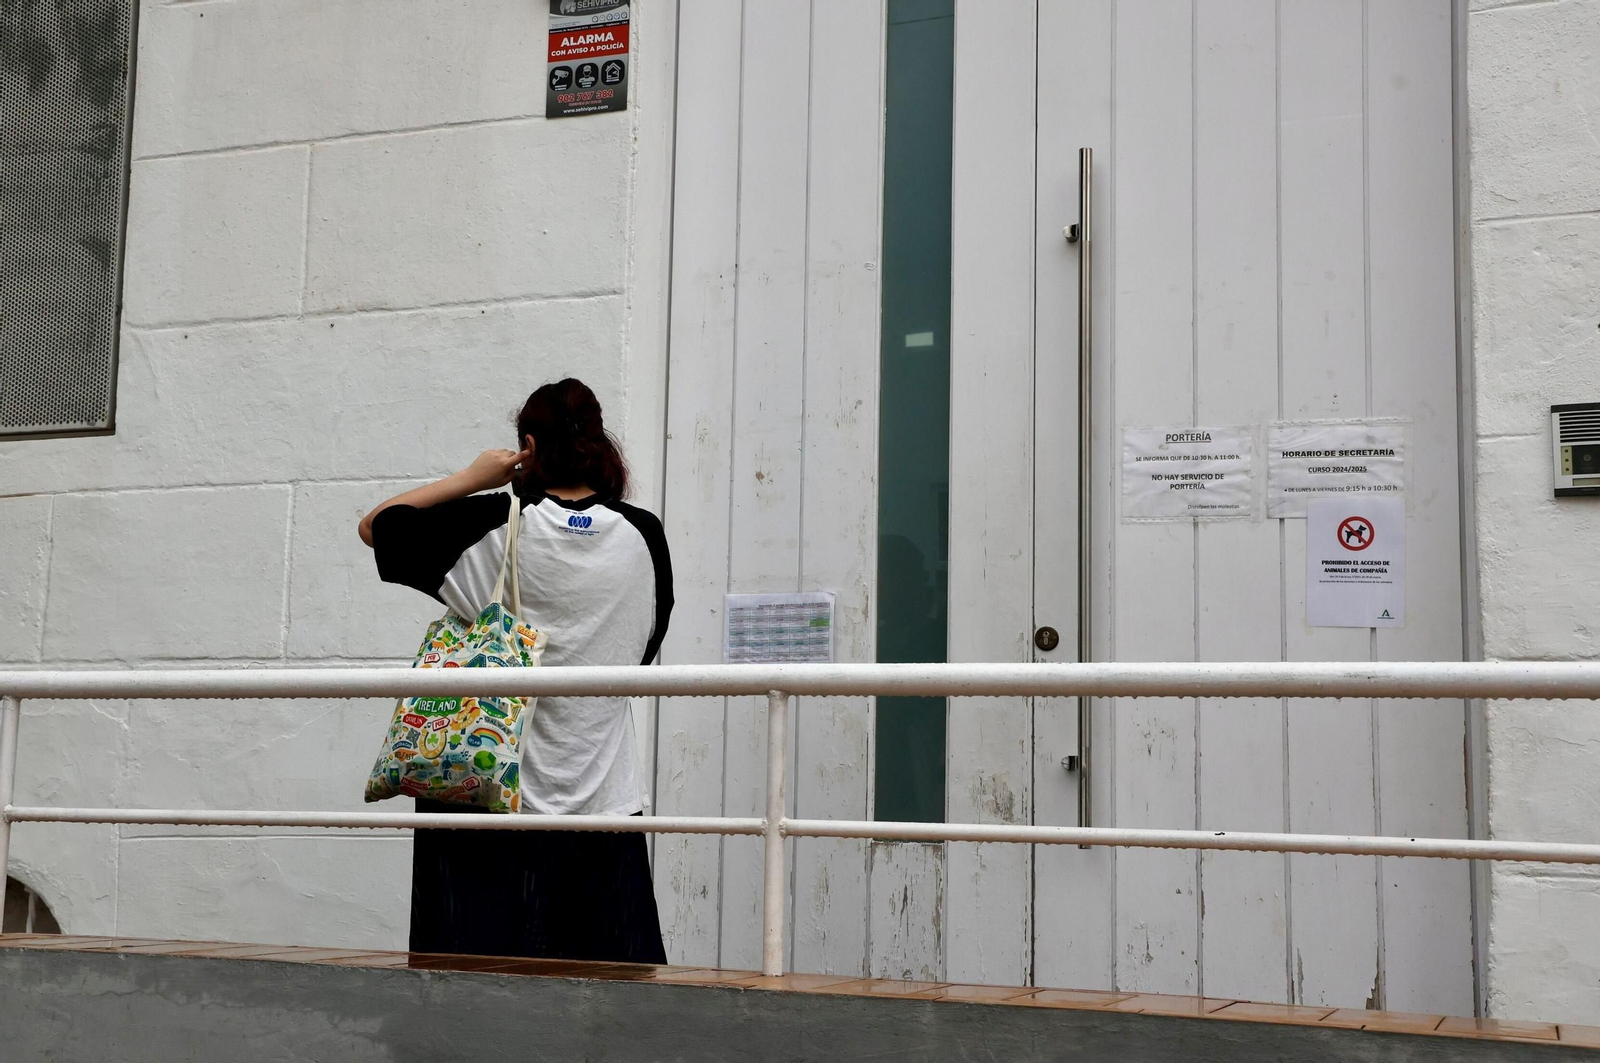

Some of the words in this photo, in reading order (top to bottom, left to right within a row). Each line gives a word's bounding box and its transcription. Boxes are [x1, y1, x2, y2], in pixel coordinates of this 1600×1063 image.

[560, 32, 615, 47] ALARMA
[551, 49, 566, 57] CON
[567, 47, 589, 55] AVISO
[596, 42, 624, 51] POLICÍA
[557, 93, 575, 103] 902
[576, 90, 594, 101] 767
[596, 88, 614, 99] 382
[563, 105, 609, 114] www.sehivipro.com
[1165, 431, 1212, 442] PORTERÍA
[1338, 448, 1395, 457] SECRETARÍA
[1164, 473, 1179, 481] HAY
[1180, 473, 1213, 481] SERVICIO
[1170, 482, 1206, 490] PORTERÍA
[418, 699, 457, 713] IRELAND
